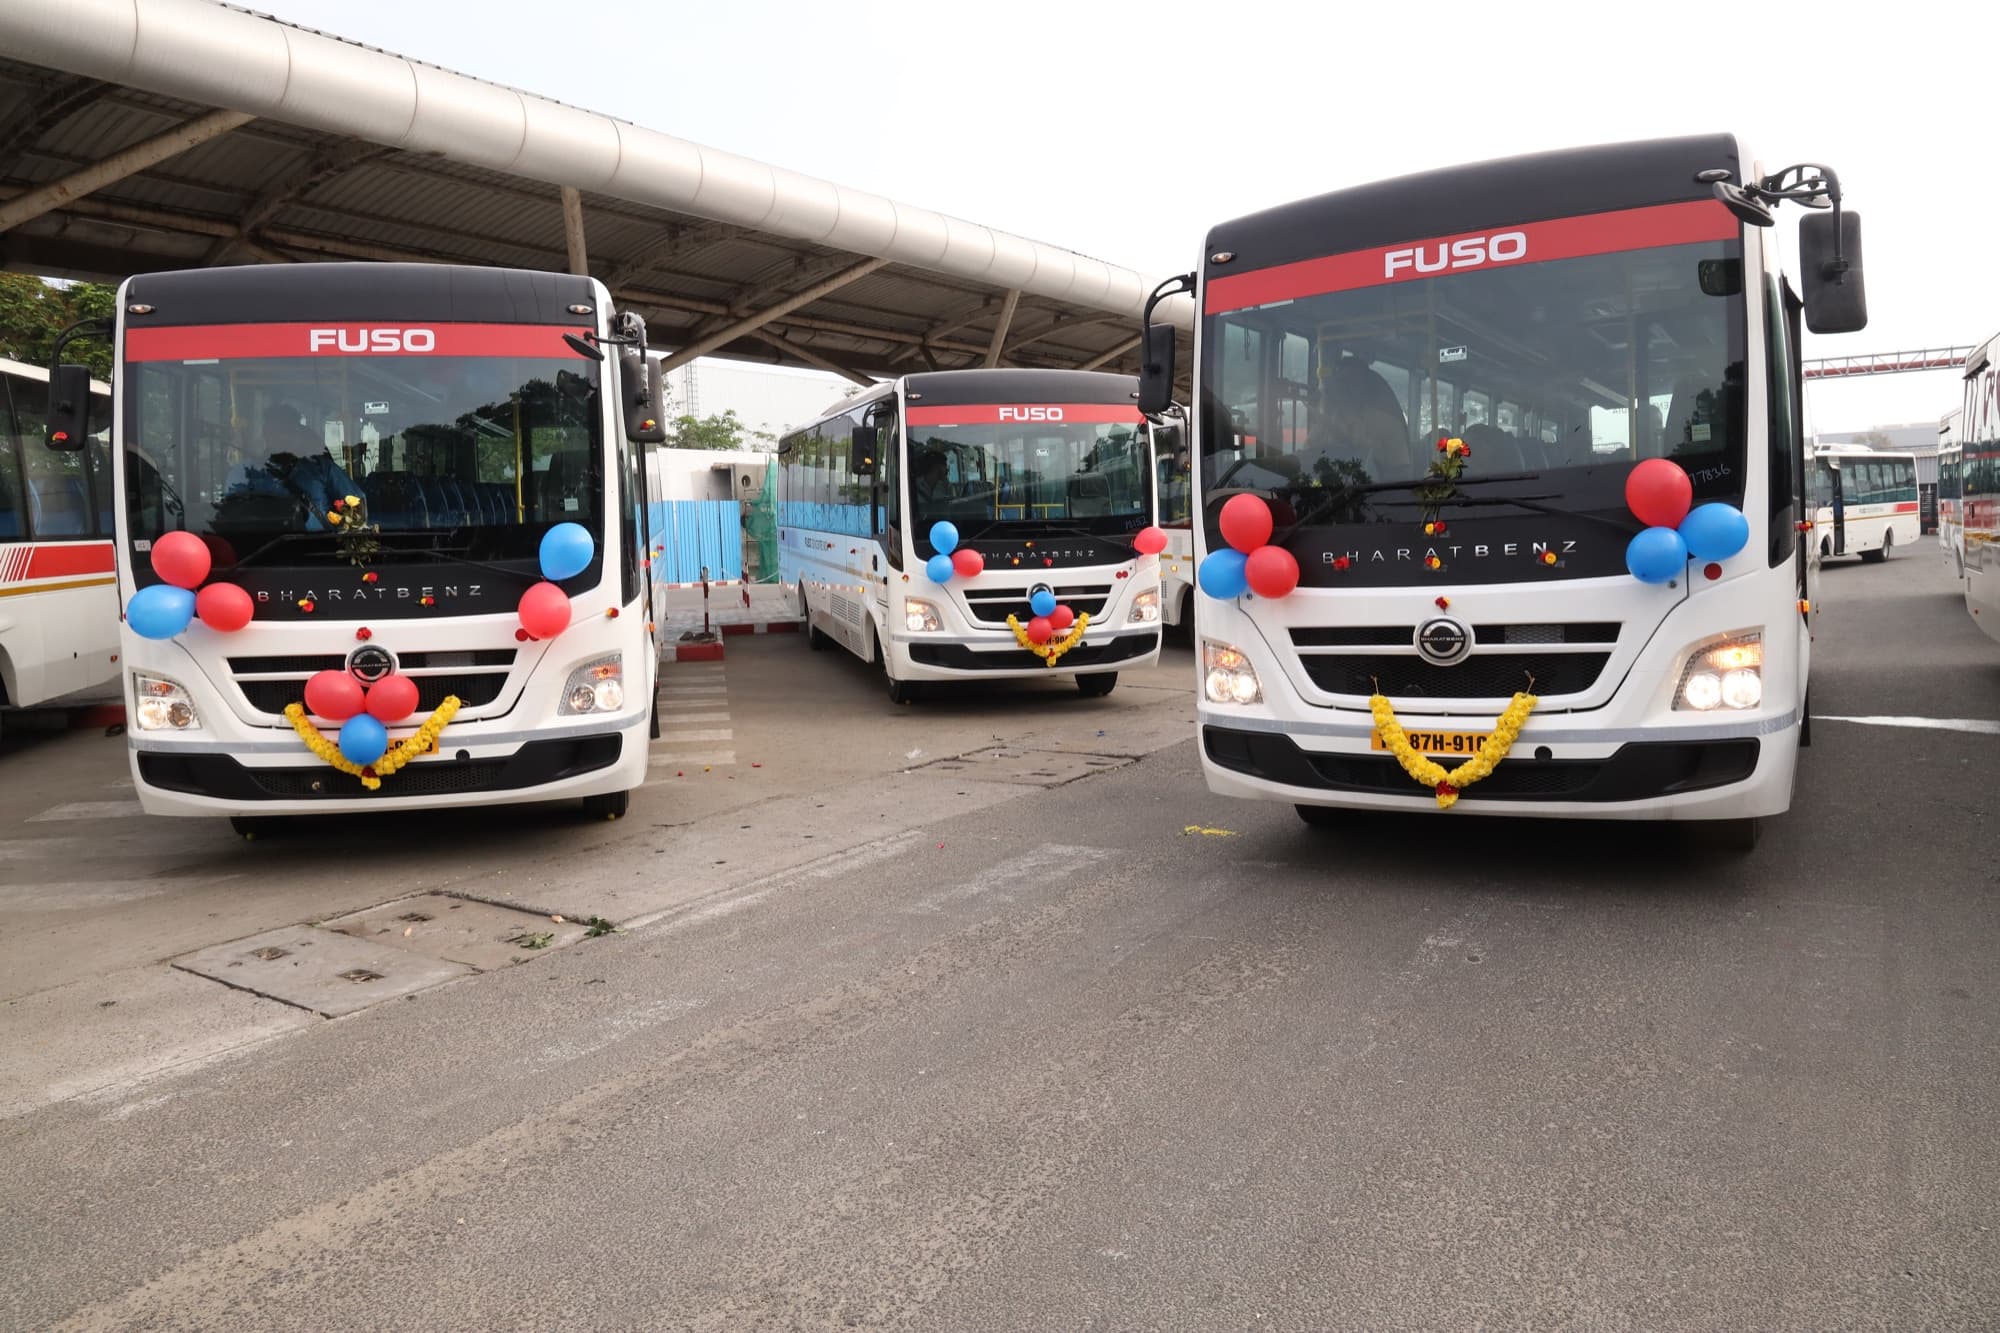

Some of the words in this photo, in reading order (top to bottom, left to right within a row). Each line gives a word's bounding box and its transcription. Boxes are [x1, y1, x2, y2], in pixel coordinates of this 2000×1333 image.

[1385, 231, 1527, 279] FUSO
[310, 328, 435, 353] FUSO
[999, 407, 1063, 421] FUSO
[1322, 540, 1577, 564] BHARATBENZ
[257, 585, 482, 601] BHARATBENZ
